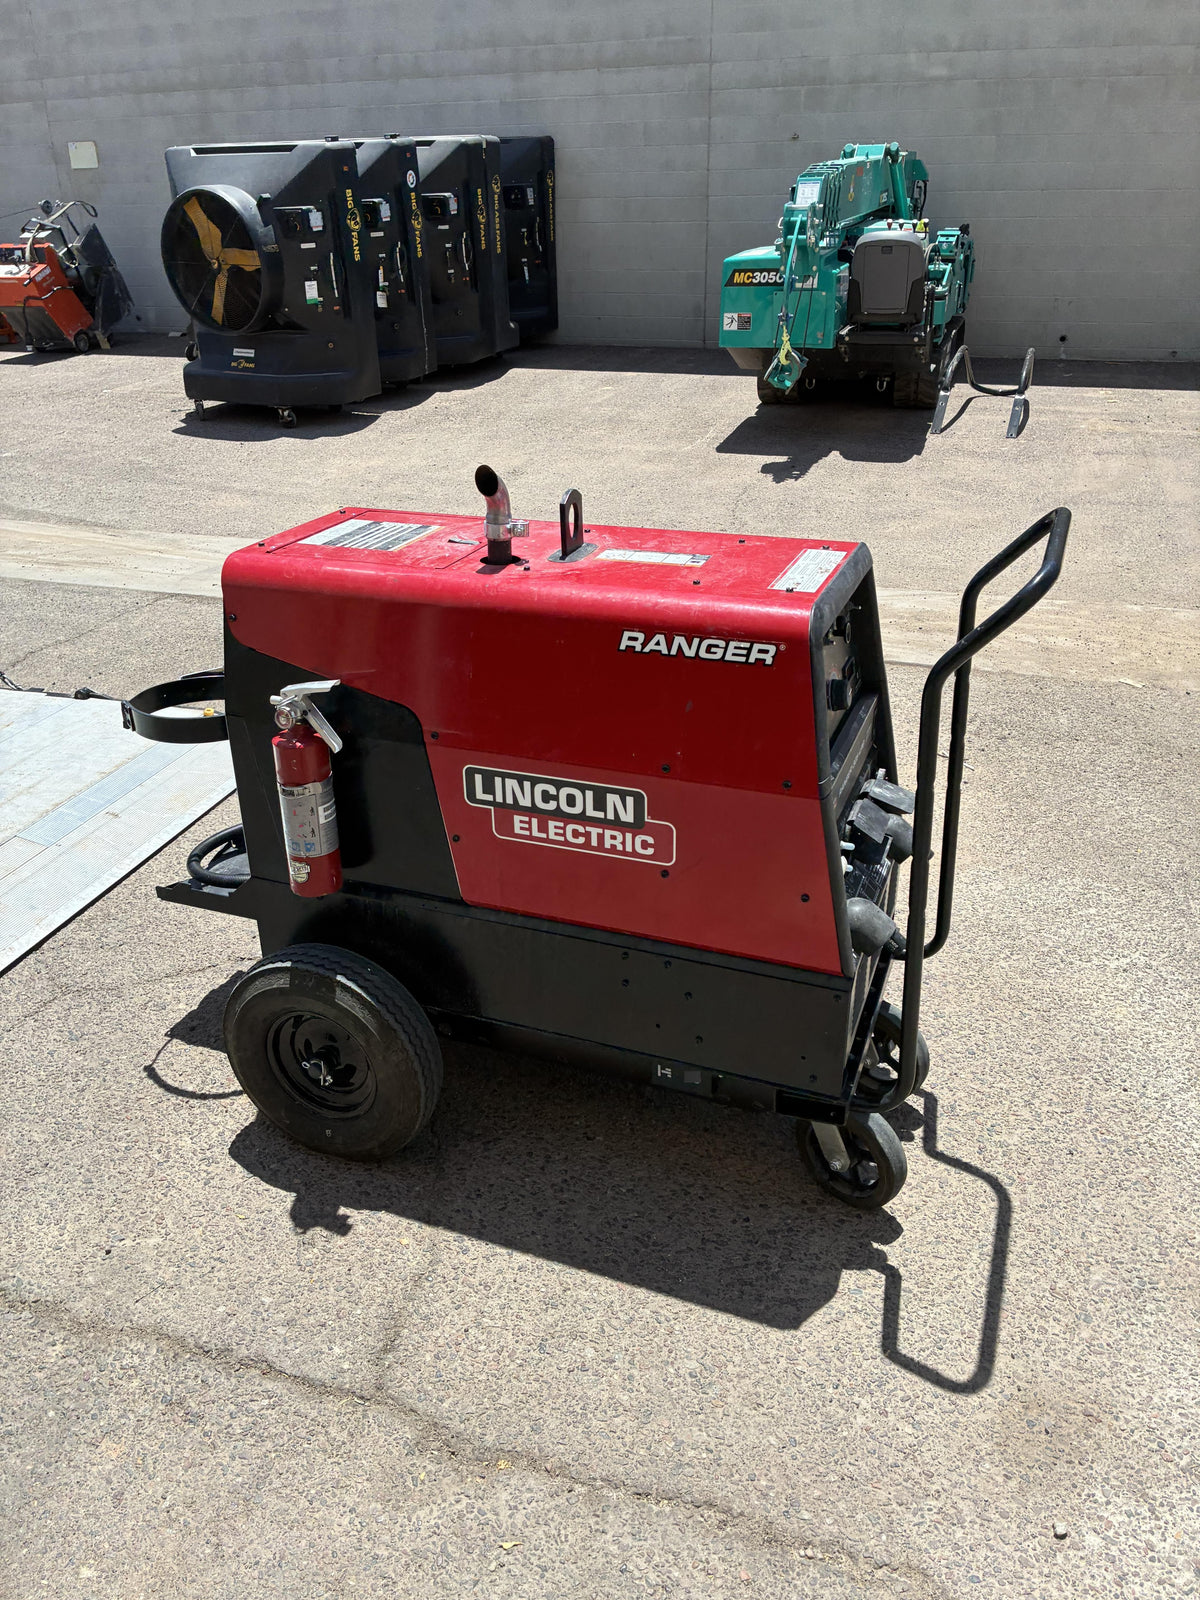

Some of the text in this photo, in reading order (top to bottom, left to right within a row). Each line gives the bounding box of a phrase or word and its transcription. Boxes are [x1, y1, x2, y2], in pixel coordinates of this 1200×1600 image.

[345, 188, 361, 262] BIG FANS
[410, 192, 423, 258] BIG FANS
[474, 773, 635, 824] LINCOLN
[513, 814, 656, 856] ELECTRIC
